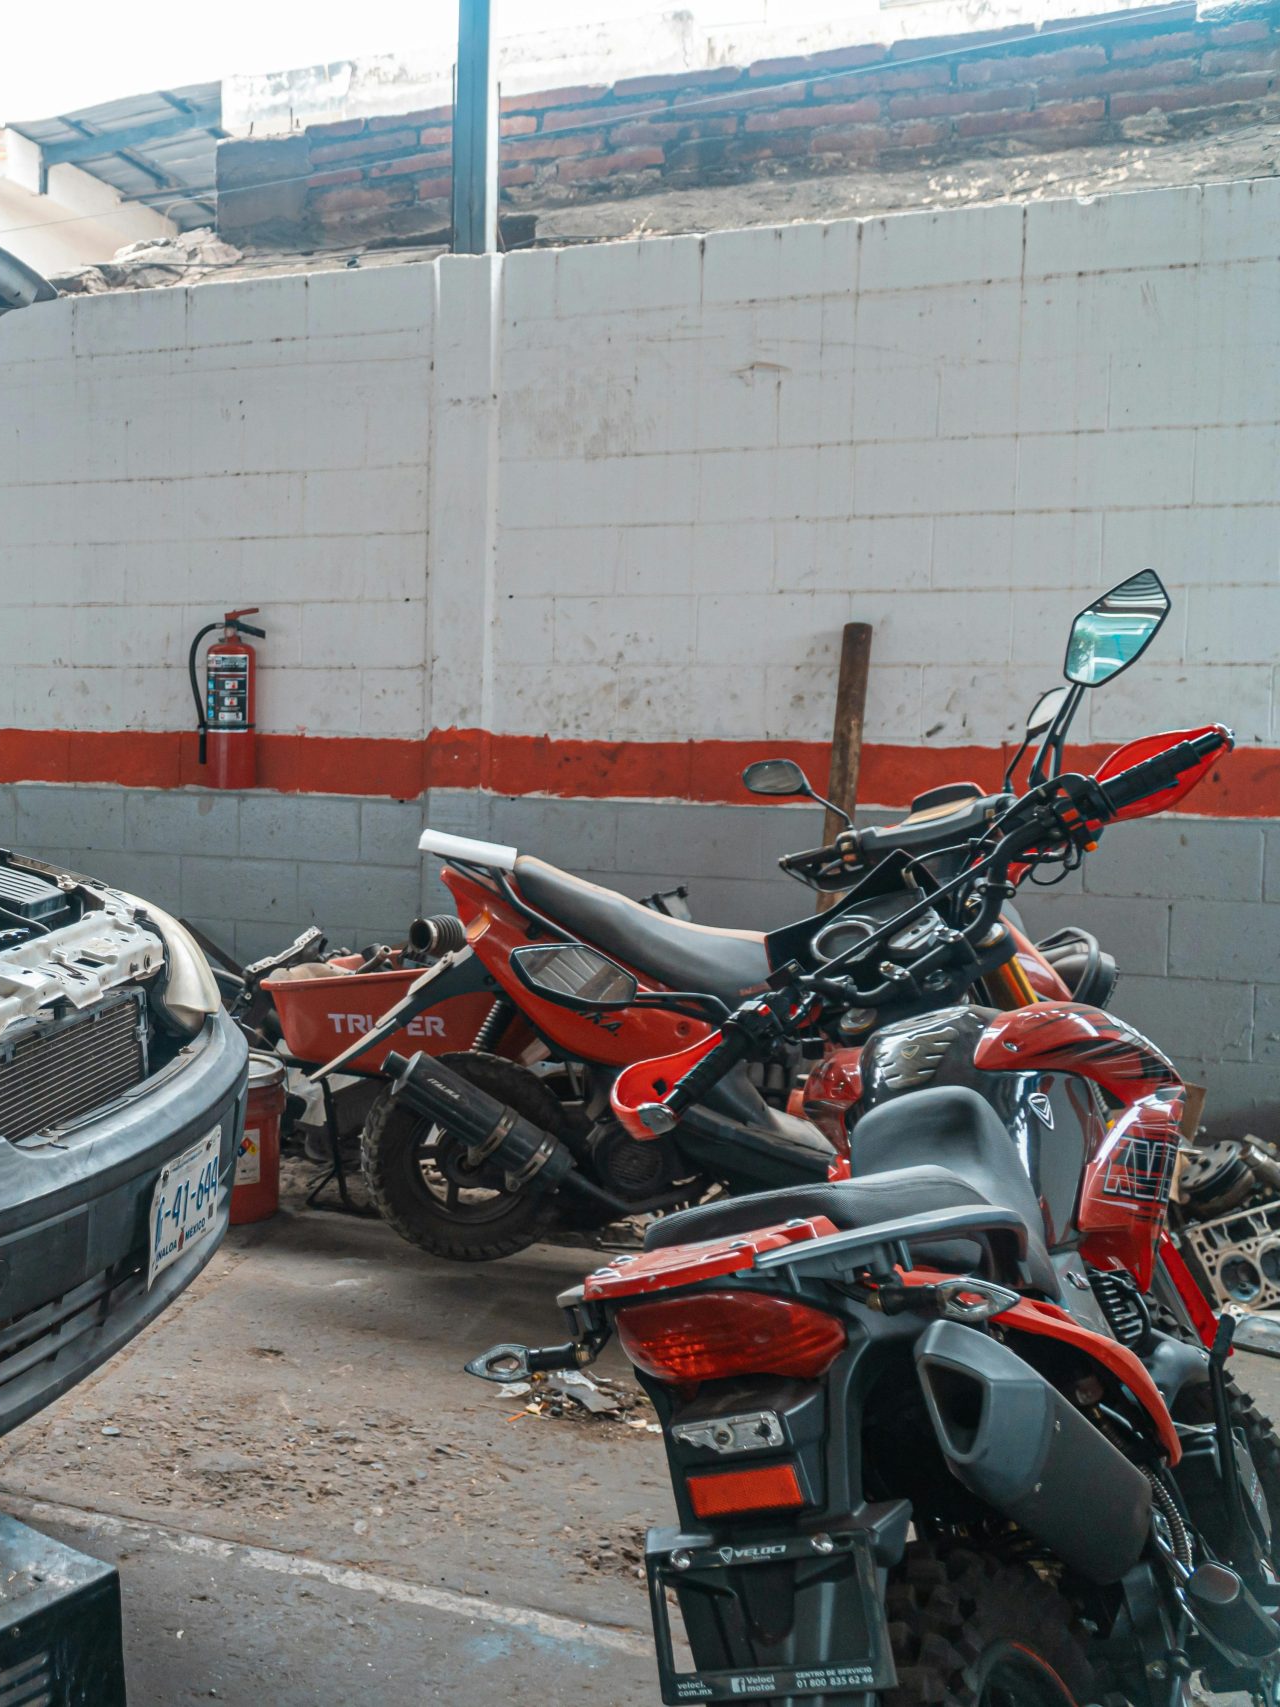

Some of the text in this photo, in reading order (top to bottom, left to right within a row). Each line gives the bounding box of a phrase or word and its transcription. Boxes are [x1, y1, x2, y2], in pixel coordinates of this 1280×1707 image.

[328, 1013, 447, 1037] TRER
[734, 1545, 787, 1558] VELOCI
[795, 1666, 872, 1679] CENTRO DE SERVICIO
[746, 1674, 775, 1685] Veloci
[747, 1683, 776, 1692] motos
